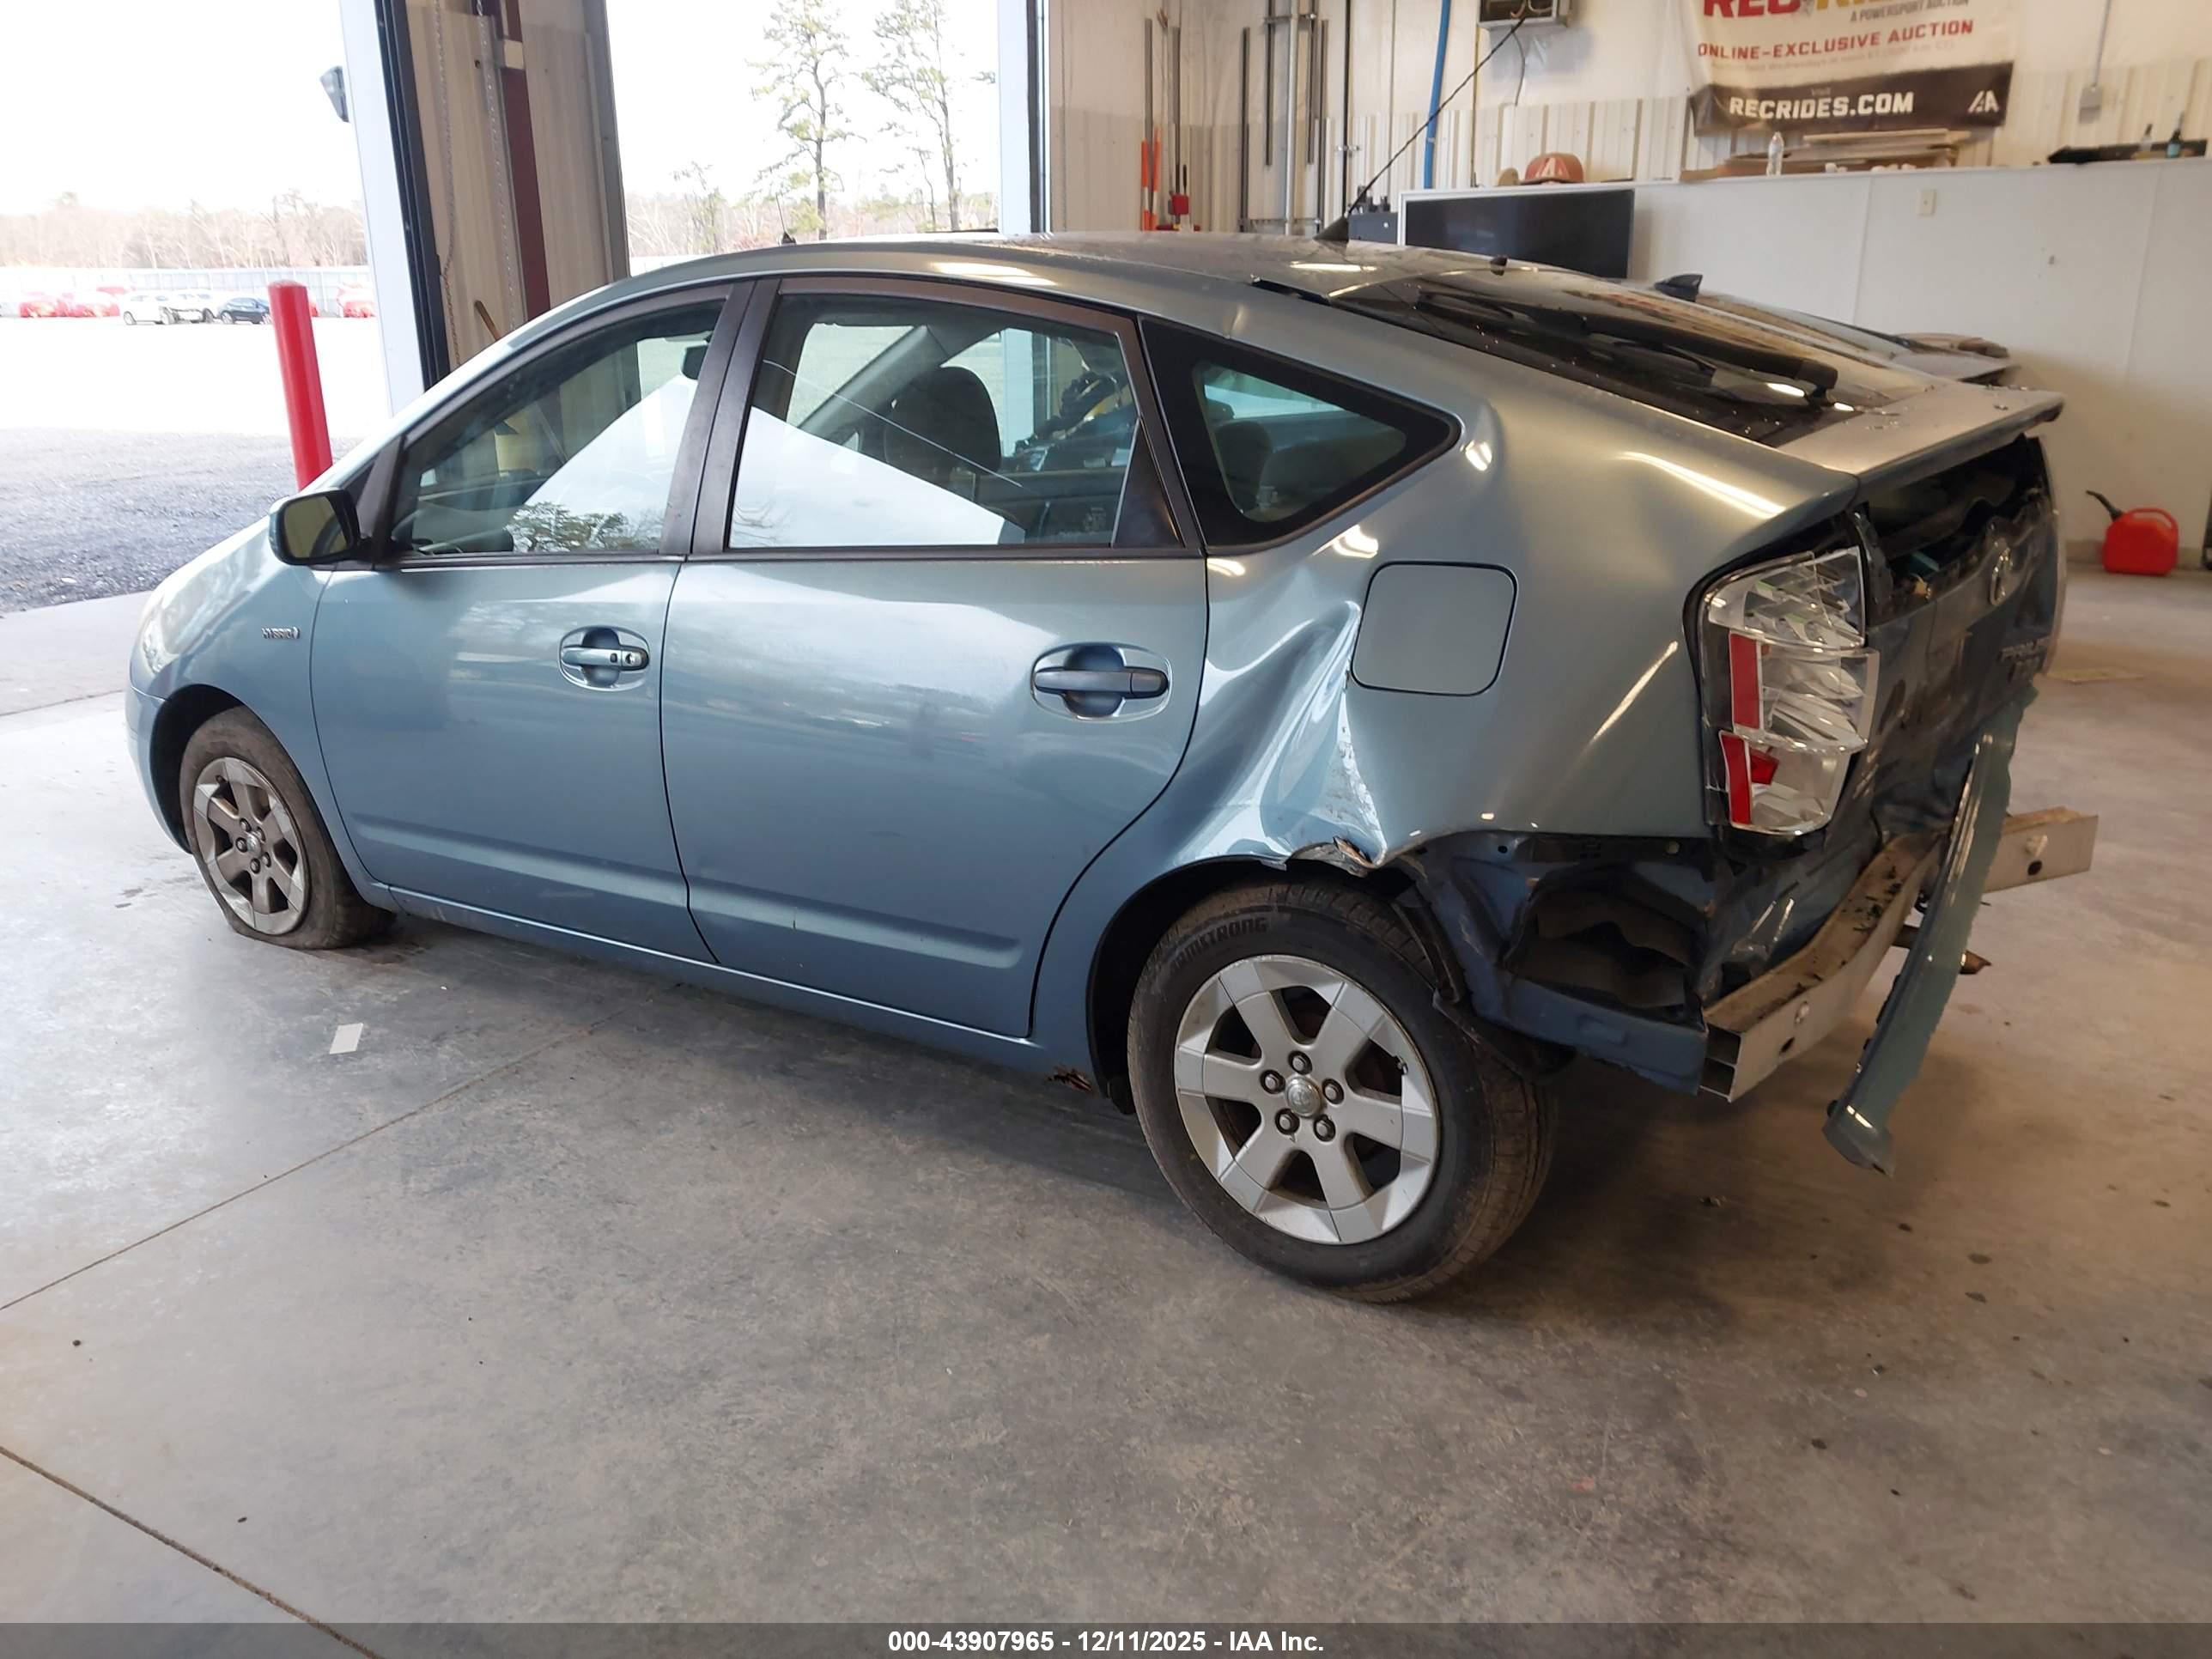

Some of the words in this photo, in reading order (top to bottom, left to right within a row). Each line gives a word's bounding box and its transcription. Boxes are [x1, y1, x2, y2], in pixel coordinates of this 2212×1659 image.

[1698, 32, 1881, 59] ONLINE-EXCLUSIVE
[1887, 20, 1974, 44] AUCTION
[1729, 91, 1914, 119] RECRIDES.COM
